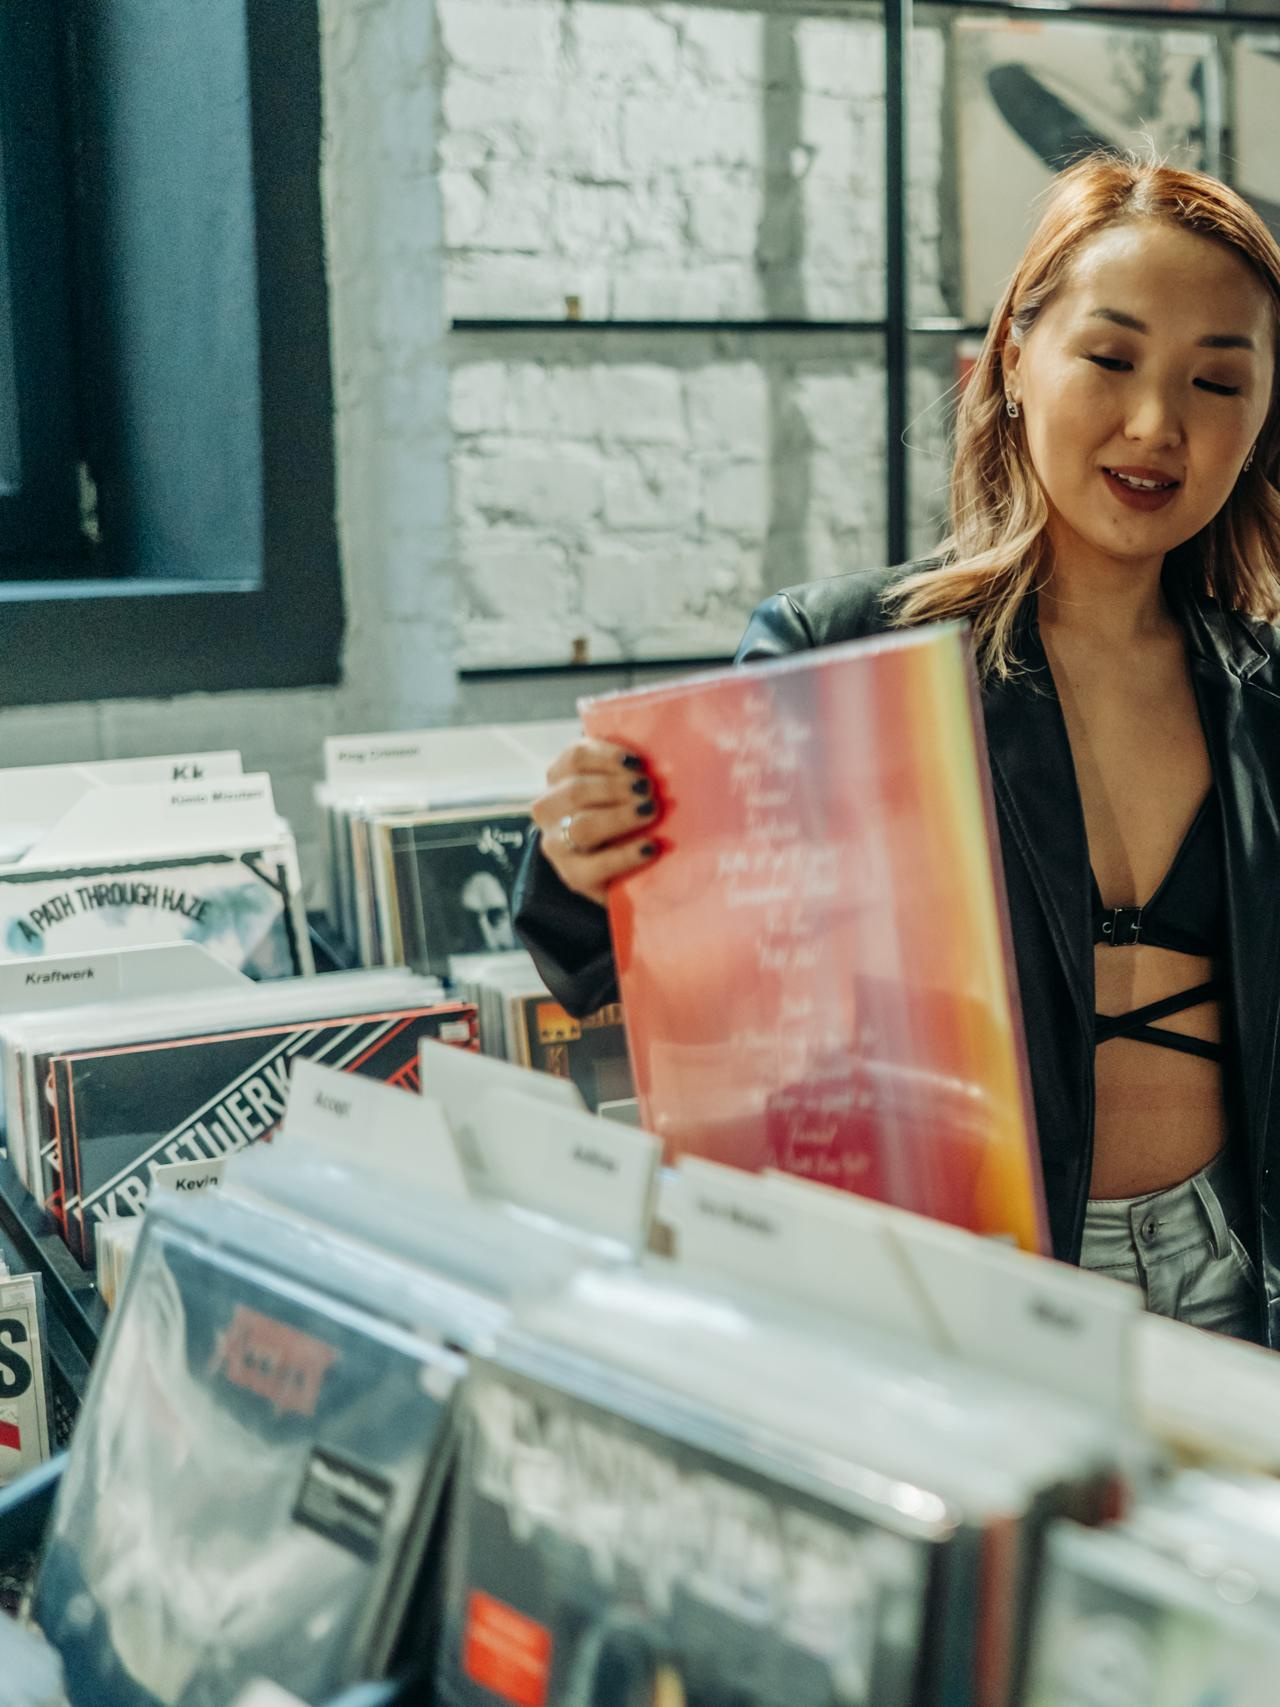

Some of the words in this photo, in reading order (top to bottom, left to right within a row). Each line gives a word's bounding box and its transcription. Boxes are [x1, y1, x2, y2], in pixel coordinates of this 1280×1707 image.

[171, 763, 204, 781] Kk
[17, 919, 39, 944] A
[29, 892, 76, 933] PATH
[74, 881, 160, 913] THROUGH
[160, 886, 213, 925] HAZE
[25, 967, 95, 985] Kraftwerk
[175, 1174, 218, 1192] Kevin
